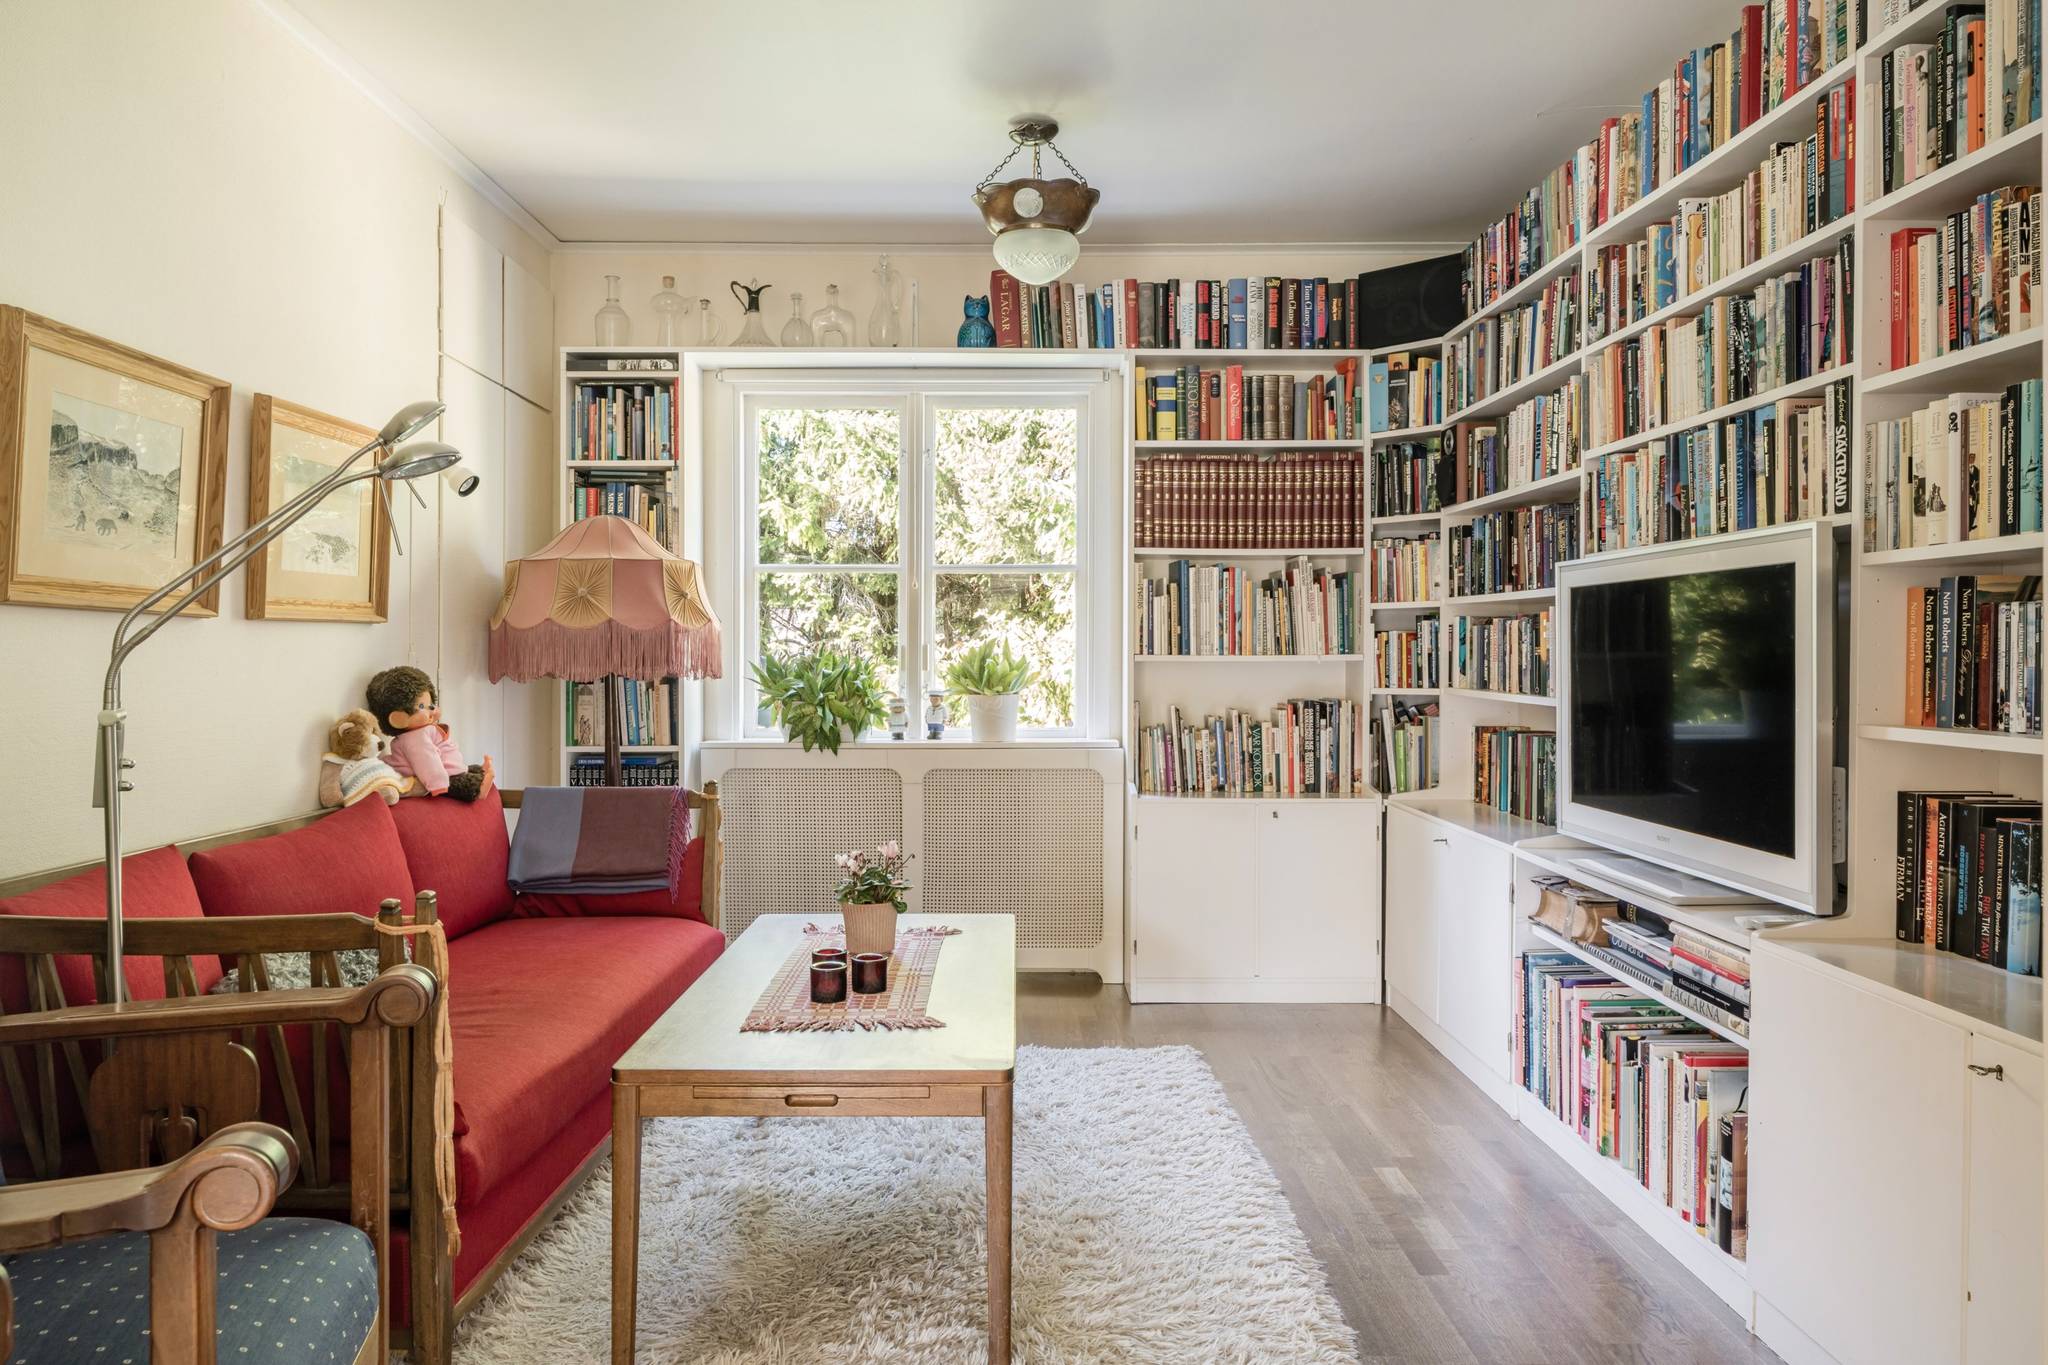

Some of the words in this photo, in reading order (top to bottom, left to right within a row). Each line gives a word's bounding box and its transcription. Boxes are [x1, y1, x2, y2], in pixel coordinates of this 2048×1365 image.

[1817, 102, 1827, 121] ÅKE
[1817, 121, 1825, 174] EDWARDSON
[2032, 222, 2041, 251] MACLEAN
[1288, 283, 1297, 300] Tom
[1304, 284, 1313, 301] Tom
[1000, 292, 1011, 332] LAGAR
[1286, 300, 1297, 327] Clancy
[1302, 301, 1313, 327] Clancy
[1188, 376, 1199, 417] STORA
[1925, 596, 1934, 622] Nora
[1942, 591, 1951, 614] Nora
[1961, 588, 1972, 610] Nora
[1910, 627, 1918, 662] Roberts
[1925, 625, 1935, 664] Roberts
[1942, 617, 1951, 652] Roberts
[1961, 612, 1972, 646] Roberts
[1253, 748, 1262, 787] KOKBOK
[1906, 799, 1914, 829] JOHN
[1938, 813, 1947, 857] AGENTEN
[1897, 856, 1906, 901] FIRMAN
[1906, 839, 1914, 893] GRISHAM
[1937, 878, 1945, 900] JOHN
